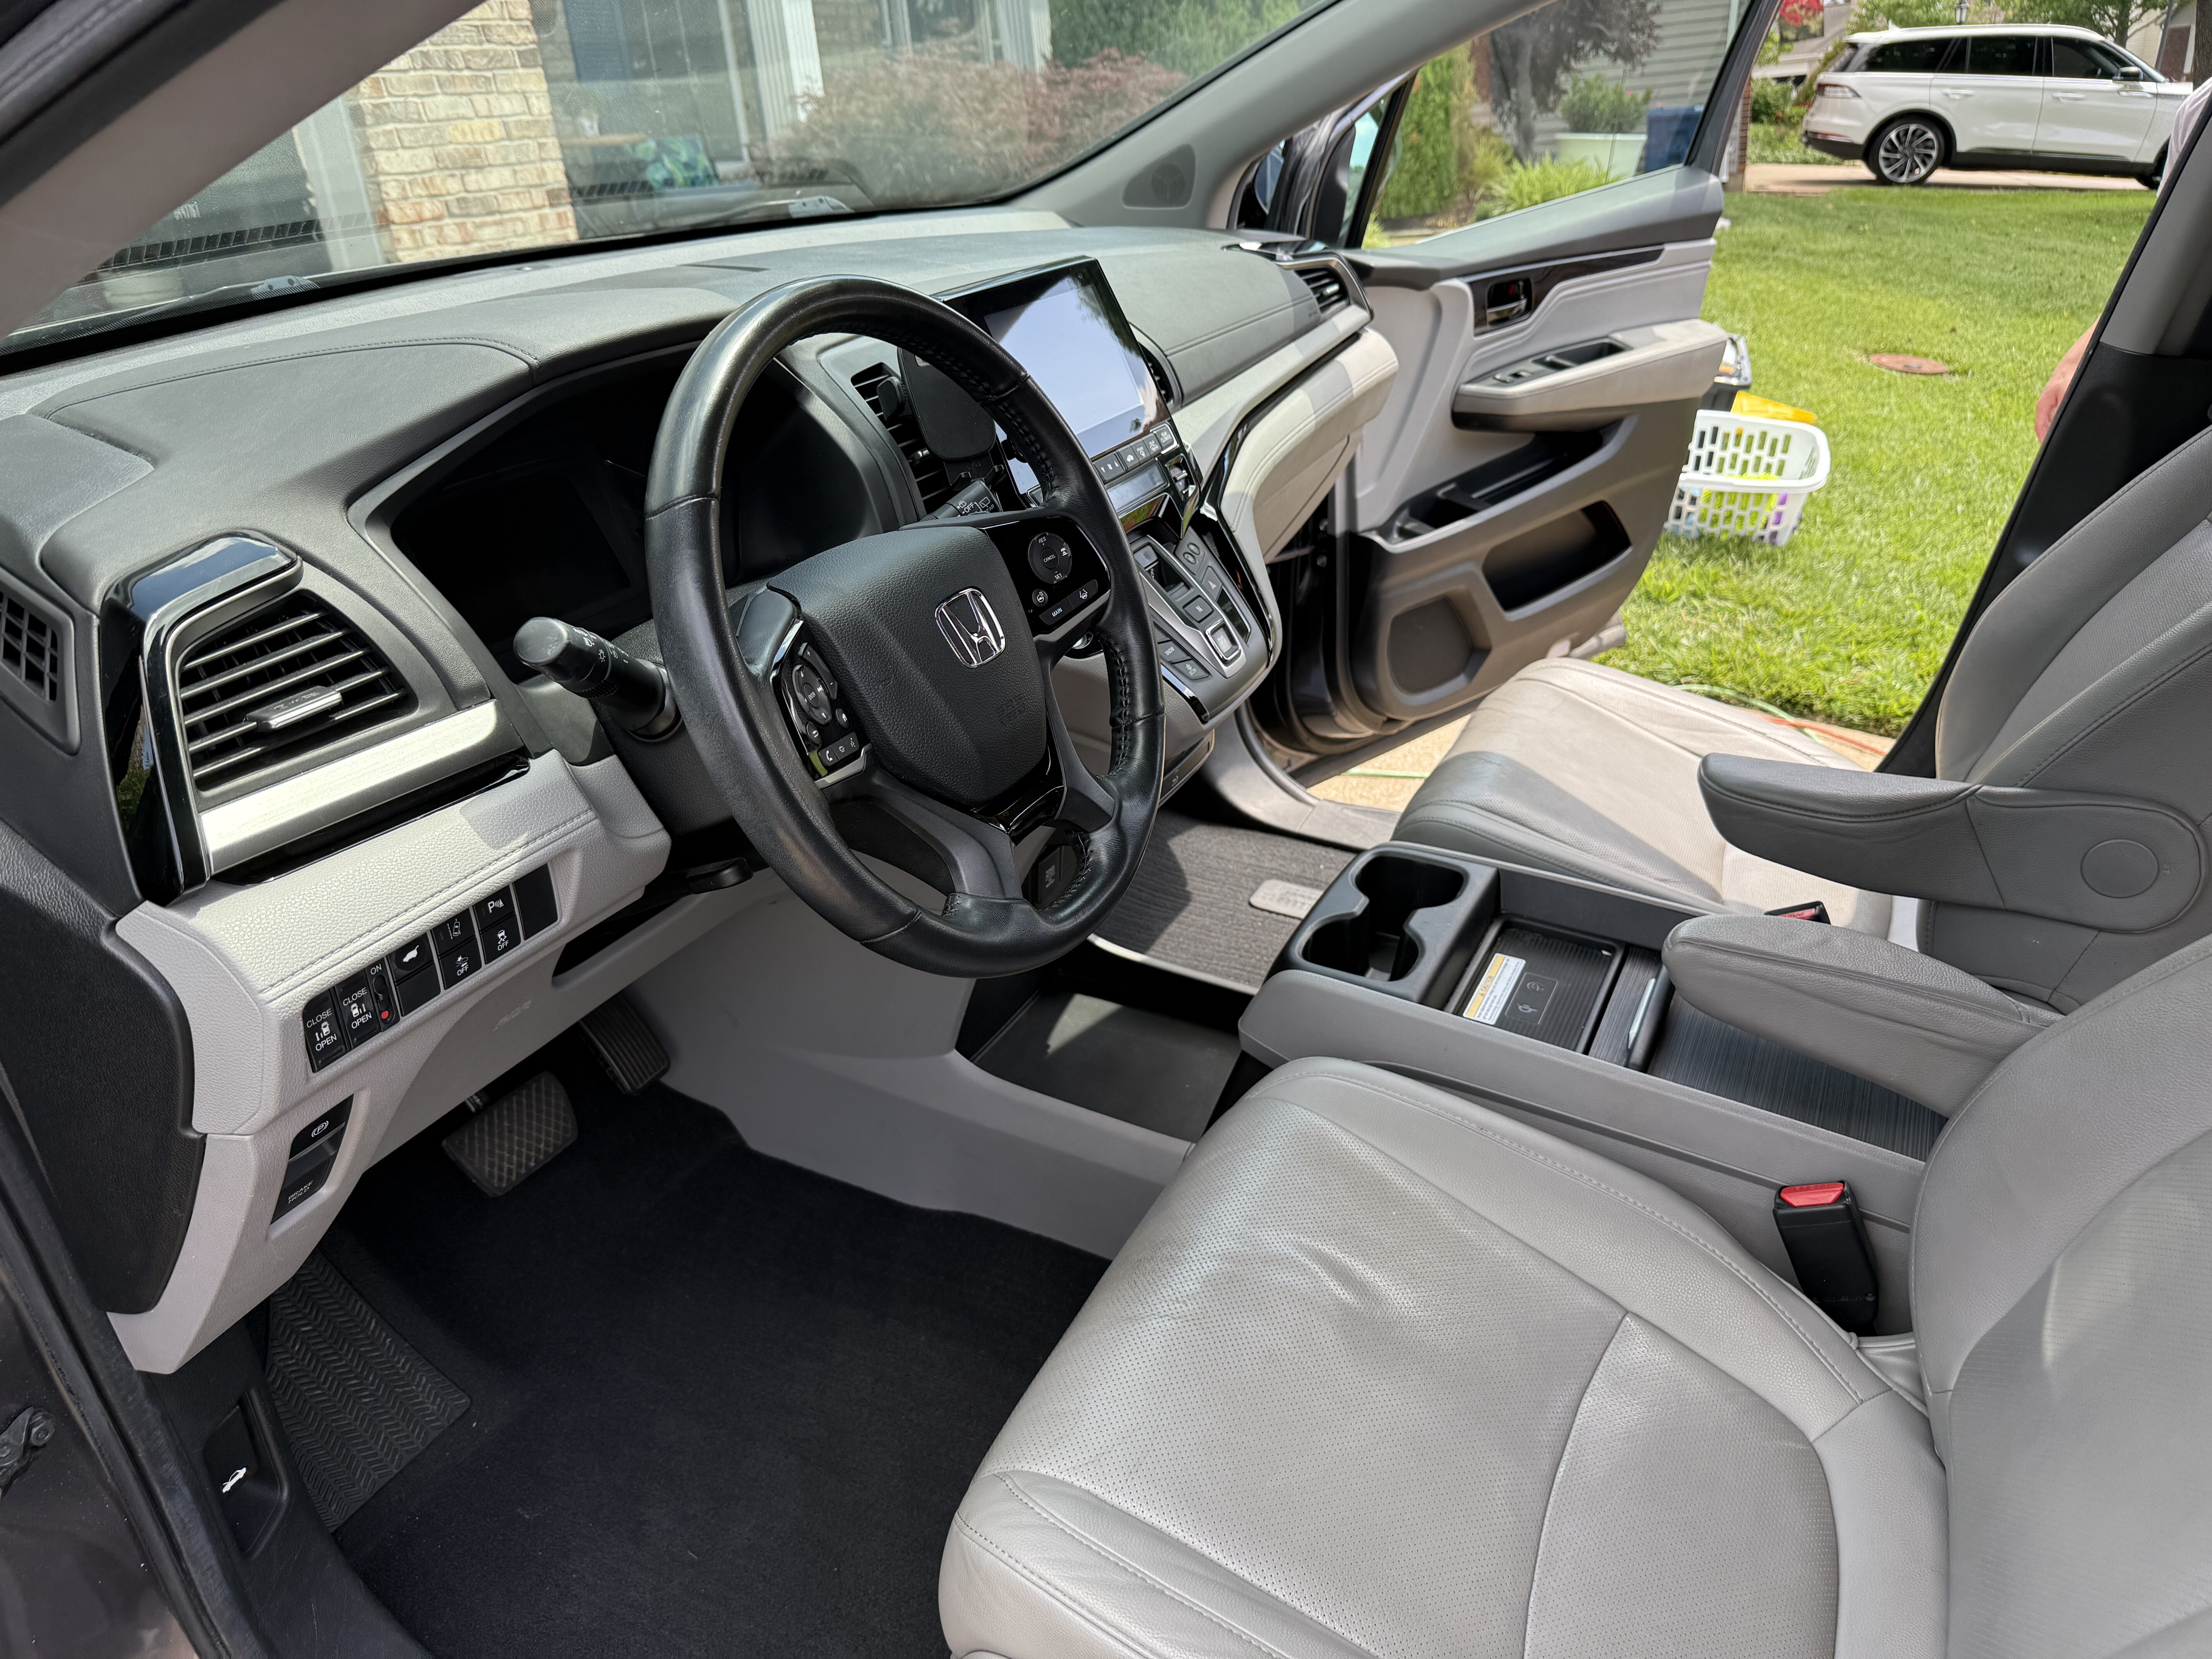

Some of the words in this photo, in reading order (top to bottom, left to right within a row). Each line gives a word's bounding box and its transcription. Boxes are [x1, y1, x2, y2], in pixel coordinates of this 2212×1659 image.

[964, 502, 974, 513] OFF
[985, 504, 995, 512] EAR
[1044, 554, 1056, 563] CANCEL
[1051, 607, 1062, 617] MAIN
[498, 940, 509, 951] OFF
[370, 964, 382, 975] ON
[457, 965, 469, 975] OFF
[343, 987, 368, 1006] CLOSE
[306, 1008, 332, 1028] CLOSE
[351, 1012, 372, 1029] OPEN
[315, 1034, 337, 1051] OPEN
[288, 1180, 313, 1200] BRAKE
[288, 1187, 309, 1204] HOLD
